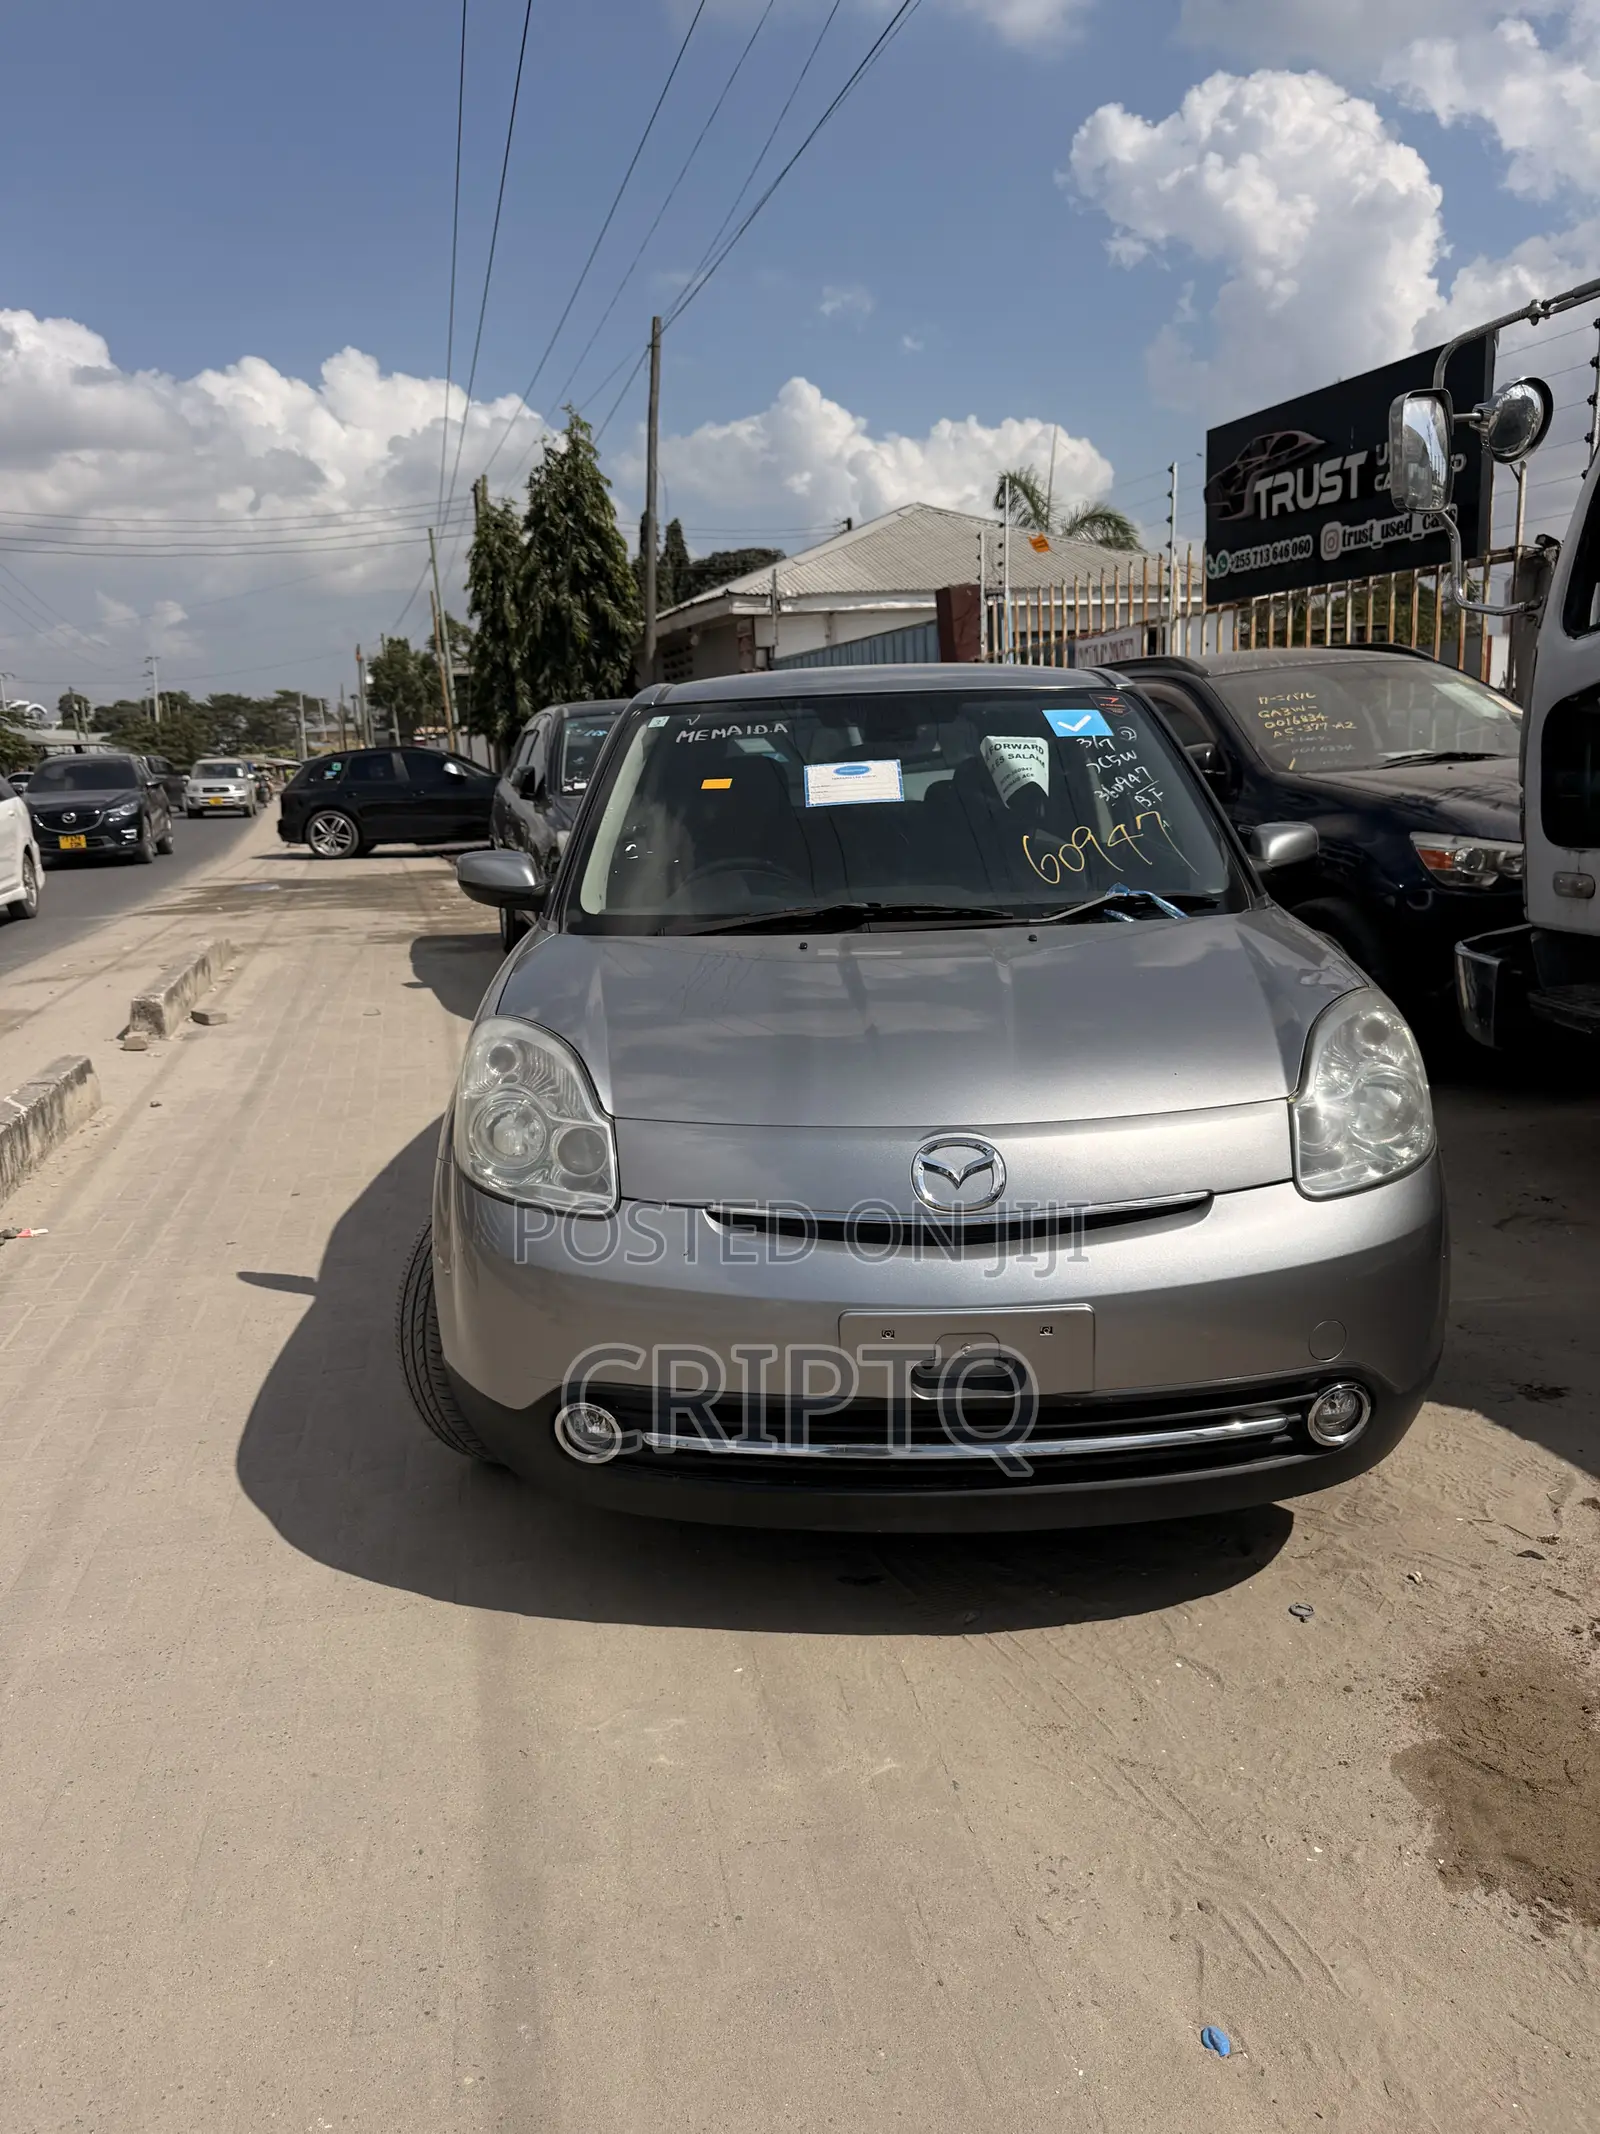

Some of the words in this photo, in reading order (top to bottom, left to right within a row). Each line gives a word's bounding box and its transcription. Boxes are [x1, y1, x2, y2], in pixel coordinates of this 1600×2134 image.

[1253, 451, 1369, 520] TRUST
[989, 743, 1045, 756] FORWARD
[1021, 811, 1200, 885] 60947
